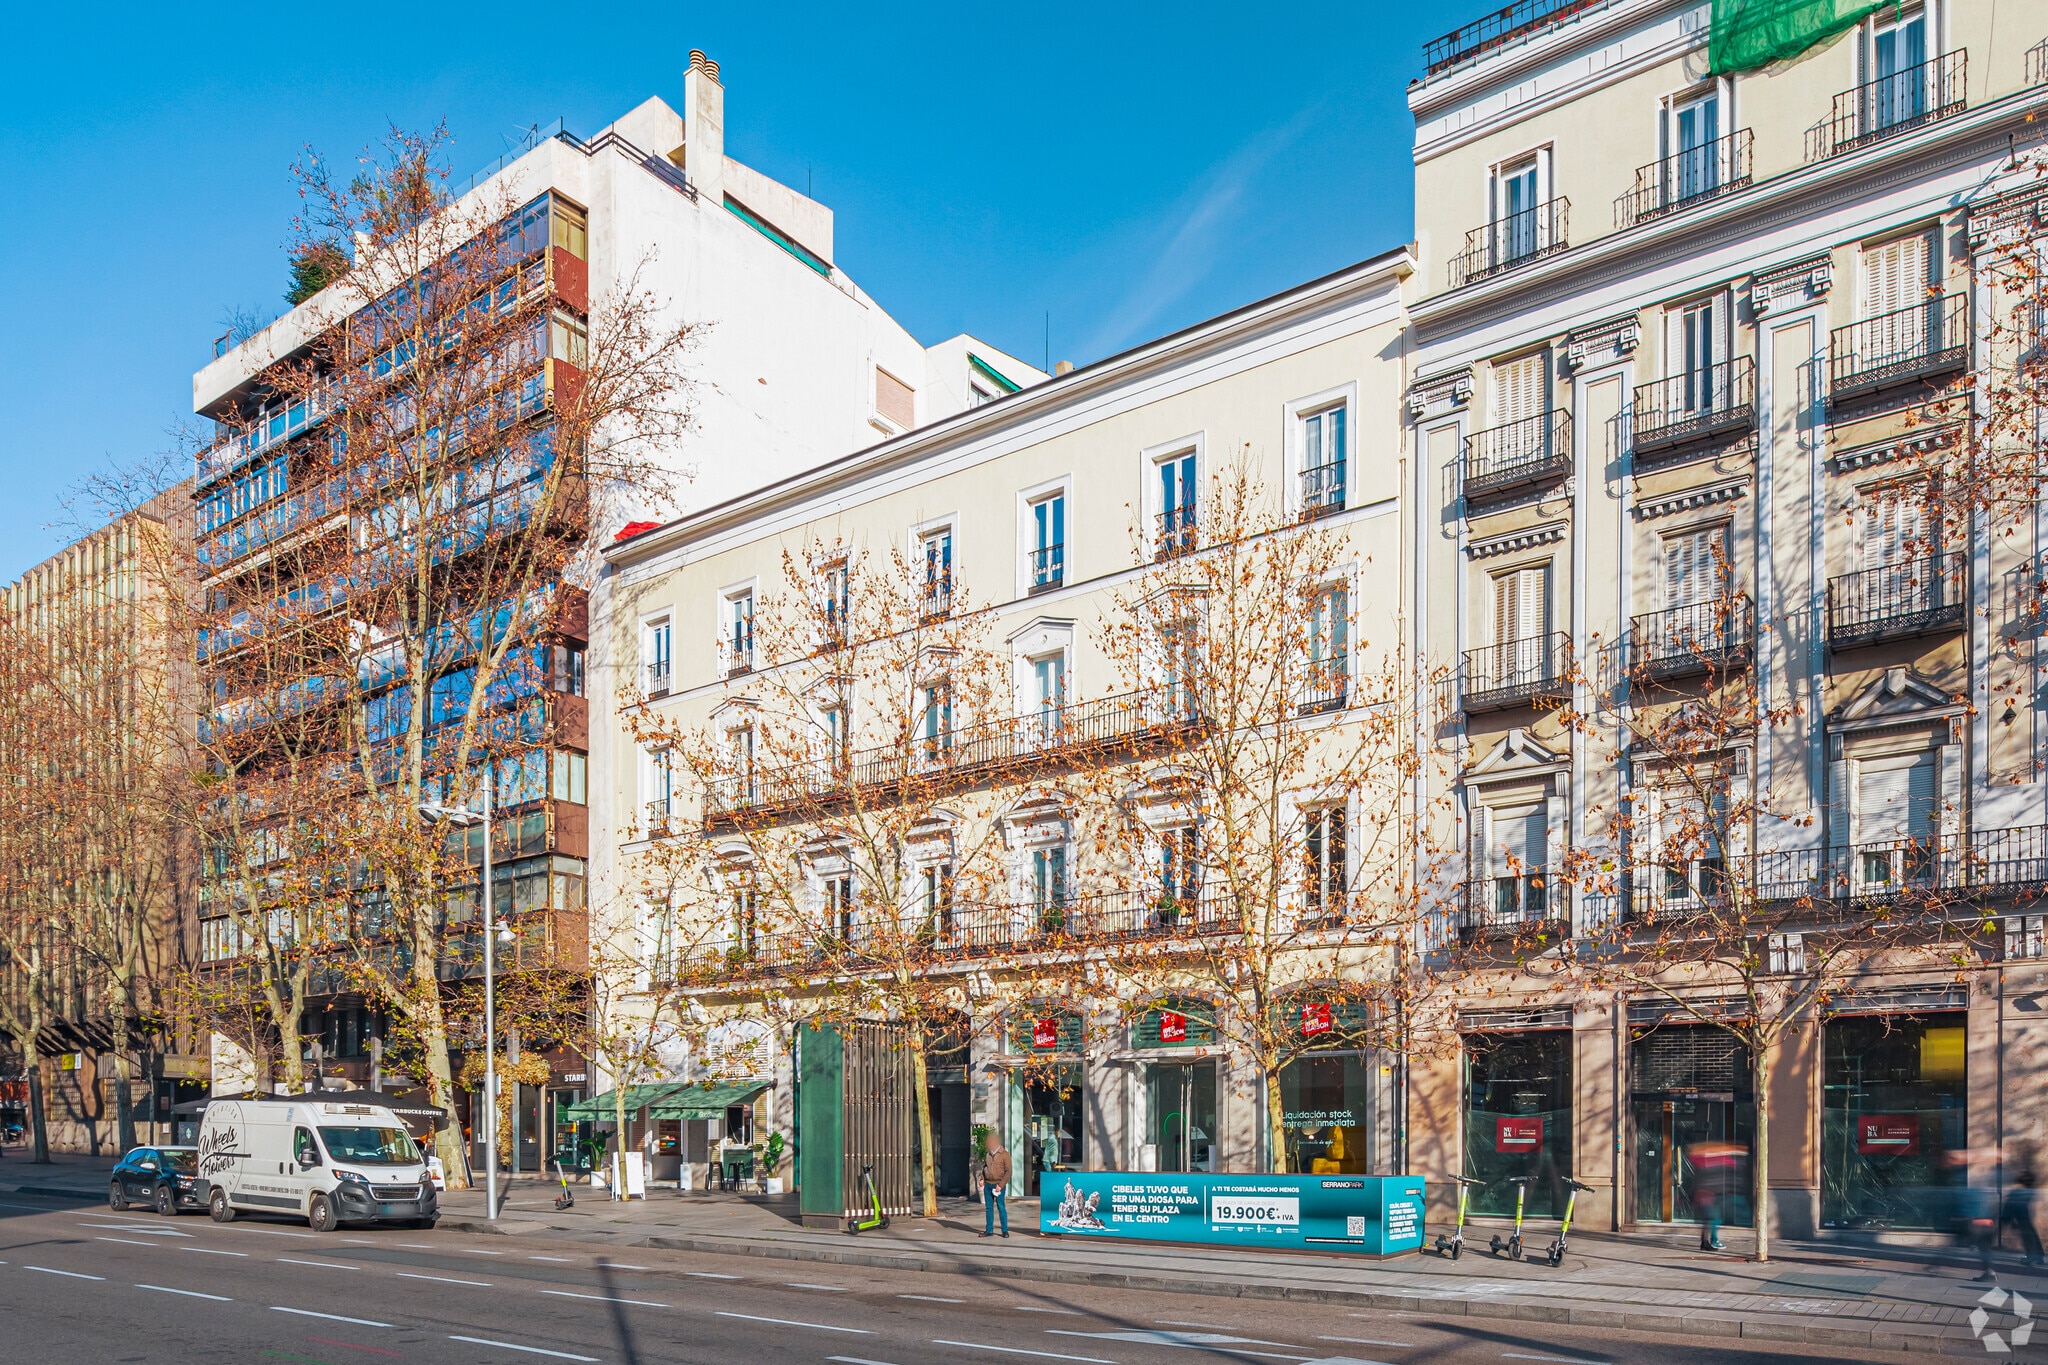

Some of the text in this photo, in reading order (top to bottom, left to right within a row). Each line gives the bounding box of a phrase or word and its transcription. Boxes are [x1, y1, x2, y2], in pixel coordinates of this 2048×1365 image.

[1306, 1022, 1328, 1032] MAISON
[564, 1074, 587, 1082] STARB
[1282, 1110, 1352, 1120] Liquidación stock
[1282, 1119, 1356, 1128] entrega inmediata
[198, 1126, 238, 1156] Wheels
[1112, 1185, 1188, 1194] CIBELES TUVO QUE
[1112, 1204, 1180, 1214] TENER SU PLAZA
[1136, 1215, 1170, 1223] CENTRO
